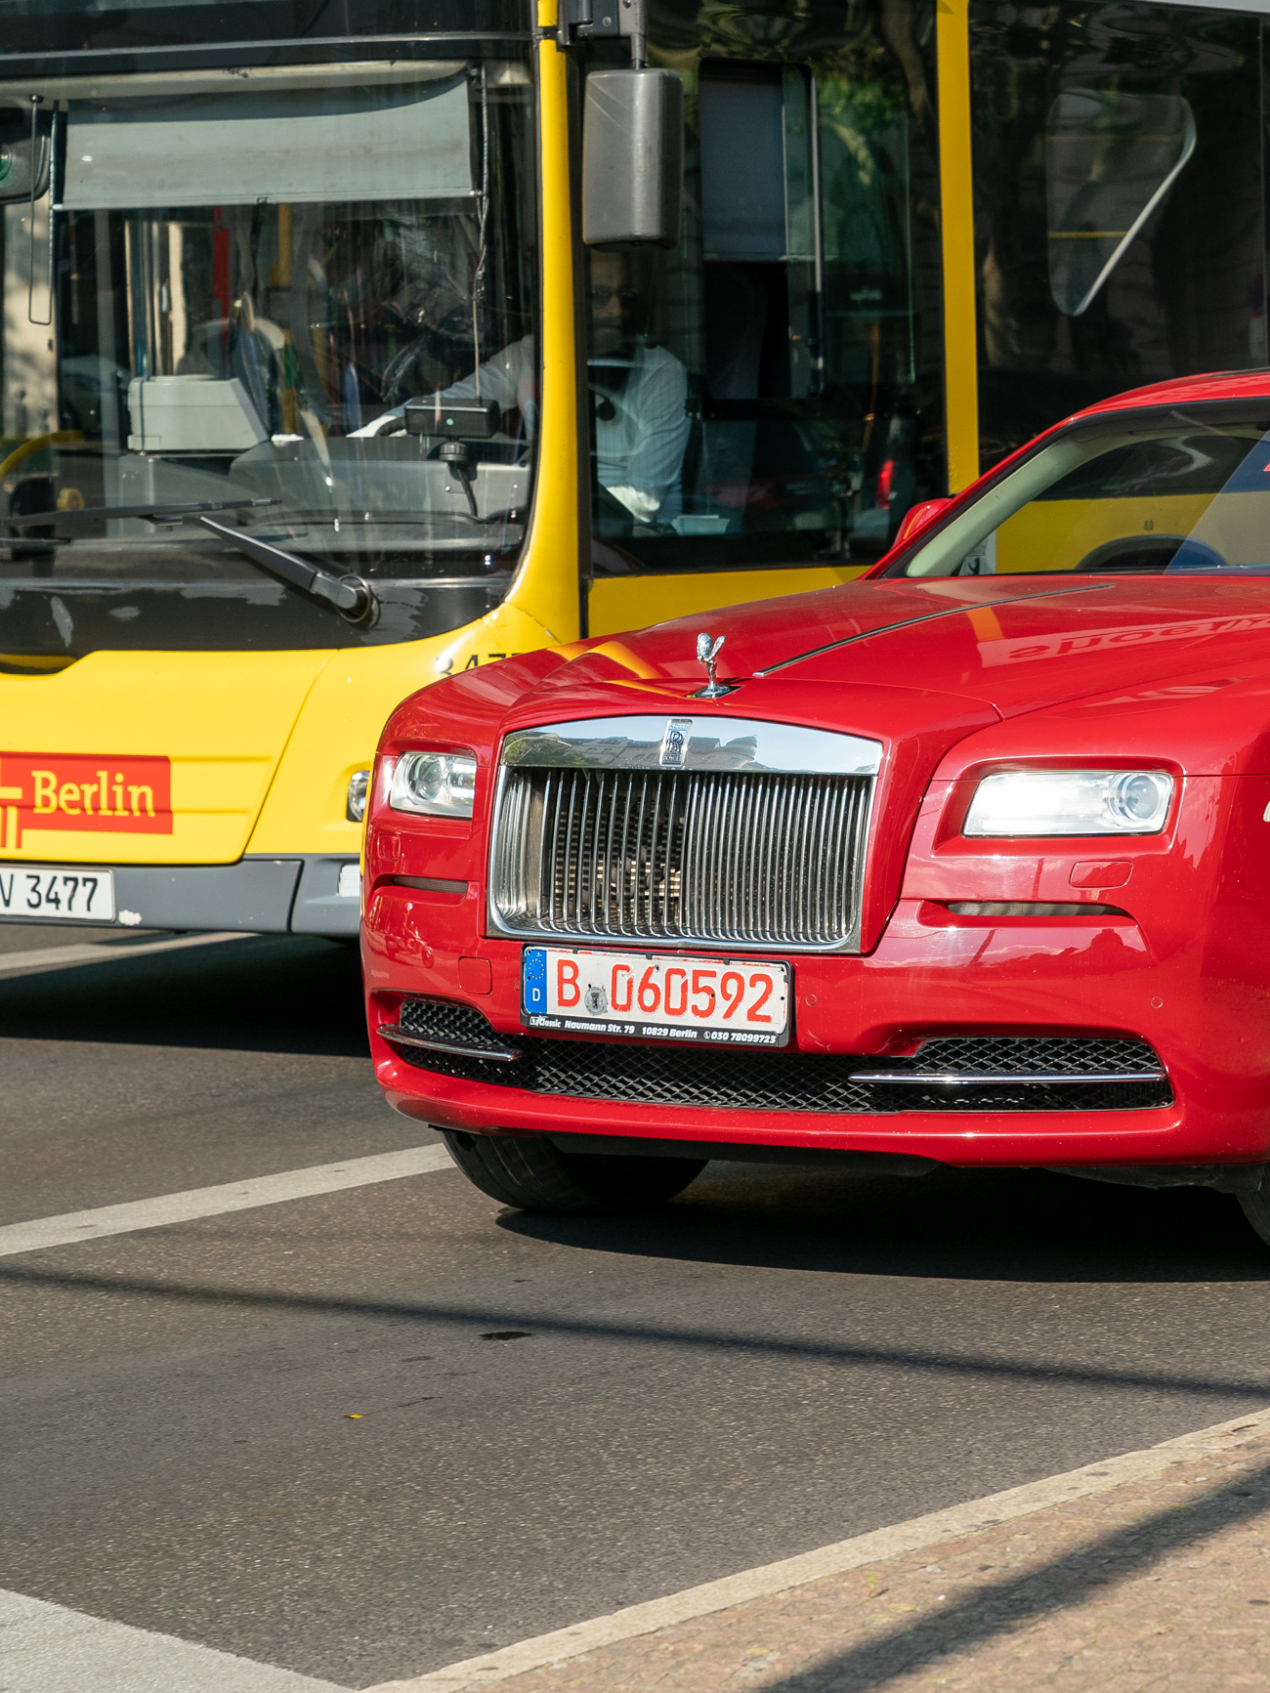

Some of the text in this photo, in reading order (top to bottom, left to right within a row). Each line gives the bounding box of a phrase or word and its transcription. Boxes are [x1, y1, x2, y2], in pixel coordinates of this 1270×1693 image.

[31, 770, 156, 817] Berlin
[26, 874, 99, 912] 3477
[532, 987, 541, 1002] D
[557, 959, 581, 1008] B
[611, 964, 774, 1024] 060592
[564, 1020, 606, 1032] Naumann
[607, 1025, 622, 1033] Str.
[624, 1026, 635, 1034] 79
[642, 1027, 668, 1037] 10829
[669, 1029, 698, 1038] Berlin
[711, 1032, 730, 1041] 030
[730, 1033, 777, 1044] 78099723
